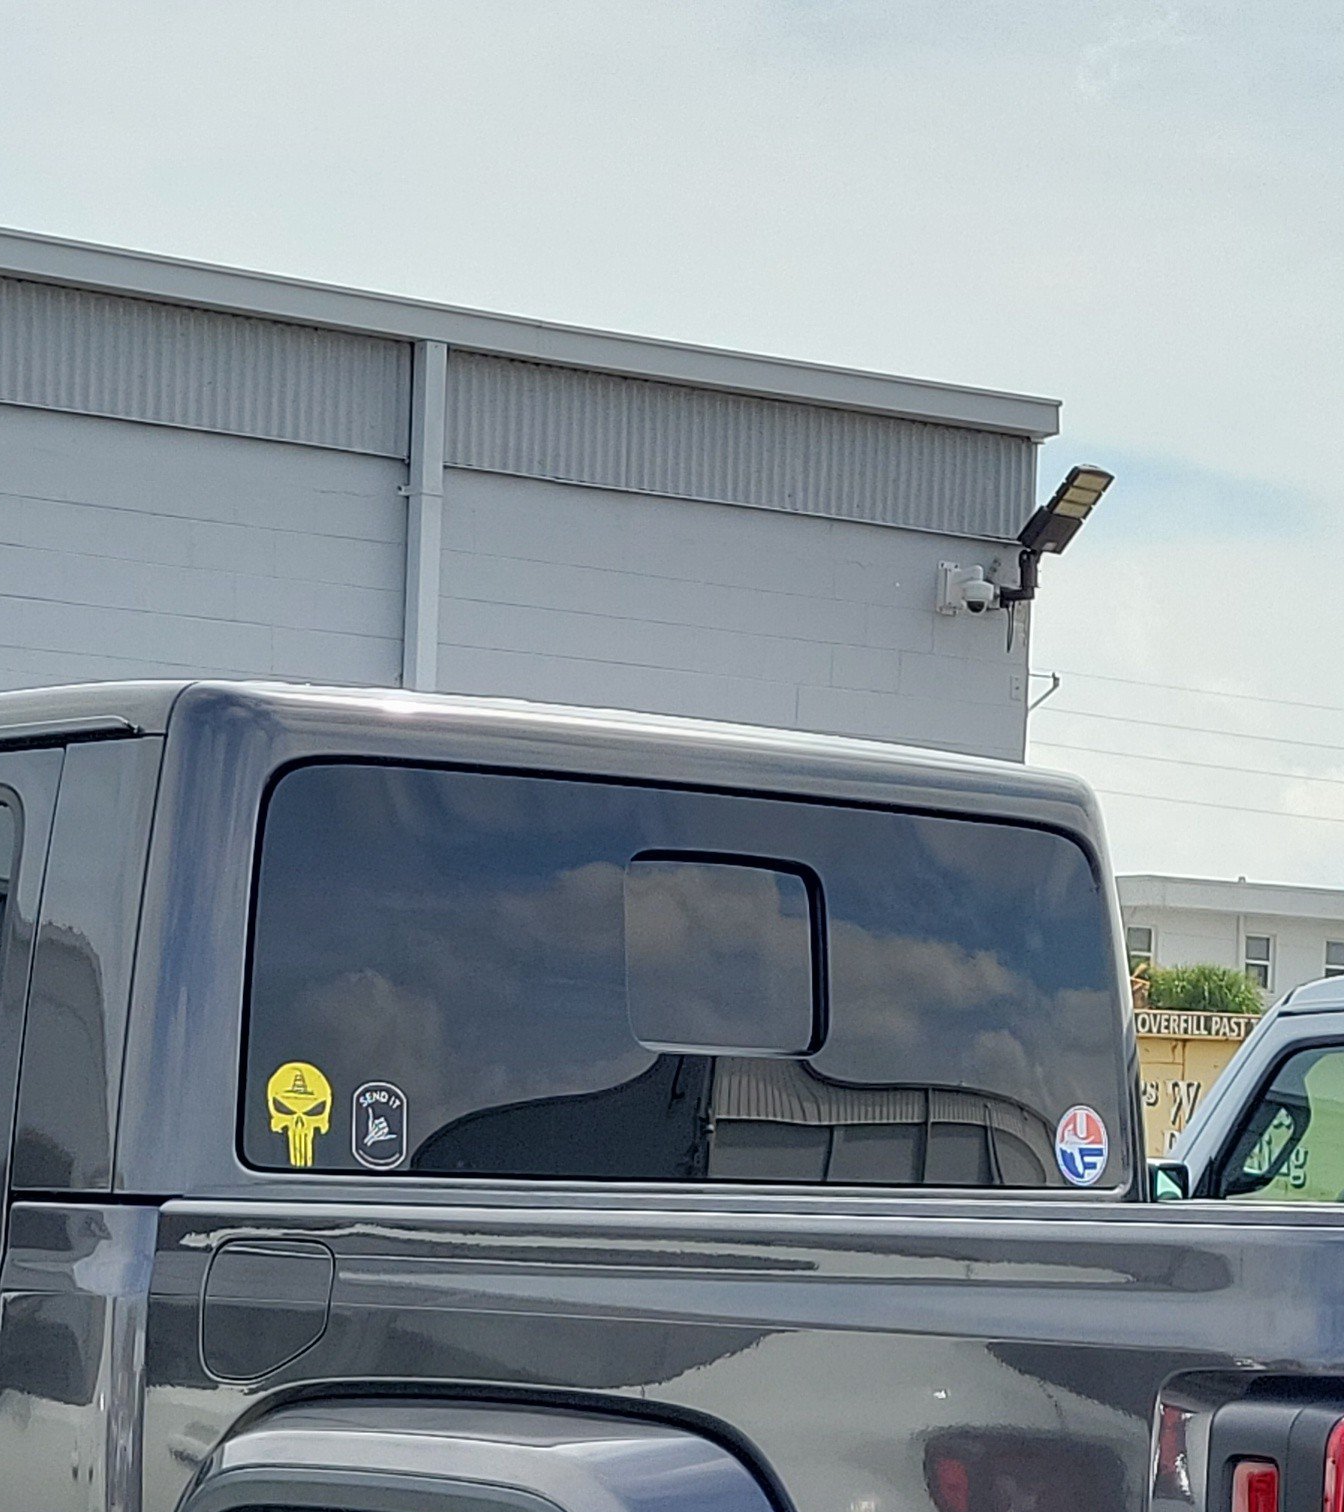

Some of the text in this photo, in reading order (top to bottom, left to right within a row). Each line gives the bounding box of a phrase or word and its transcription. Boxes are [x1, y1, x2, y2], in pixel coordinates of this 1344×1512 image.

[1137, 1013, 1208, 1035] OVERFILL
[1211, 1017, 1248, 1036] PAST
[359, 1090, 401, 1109] SEND IT
